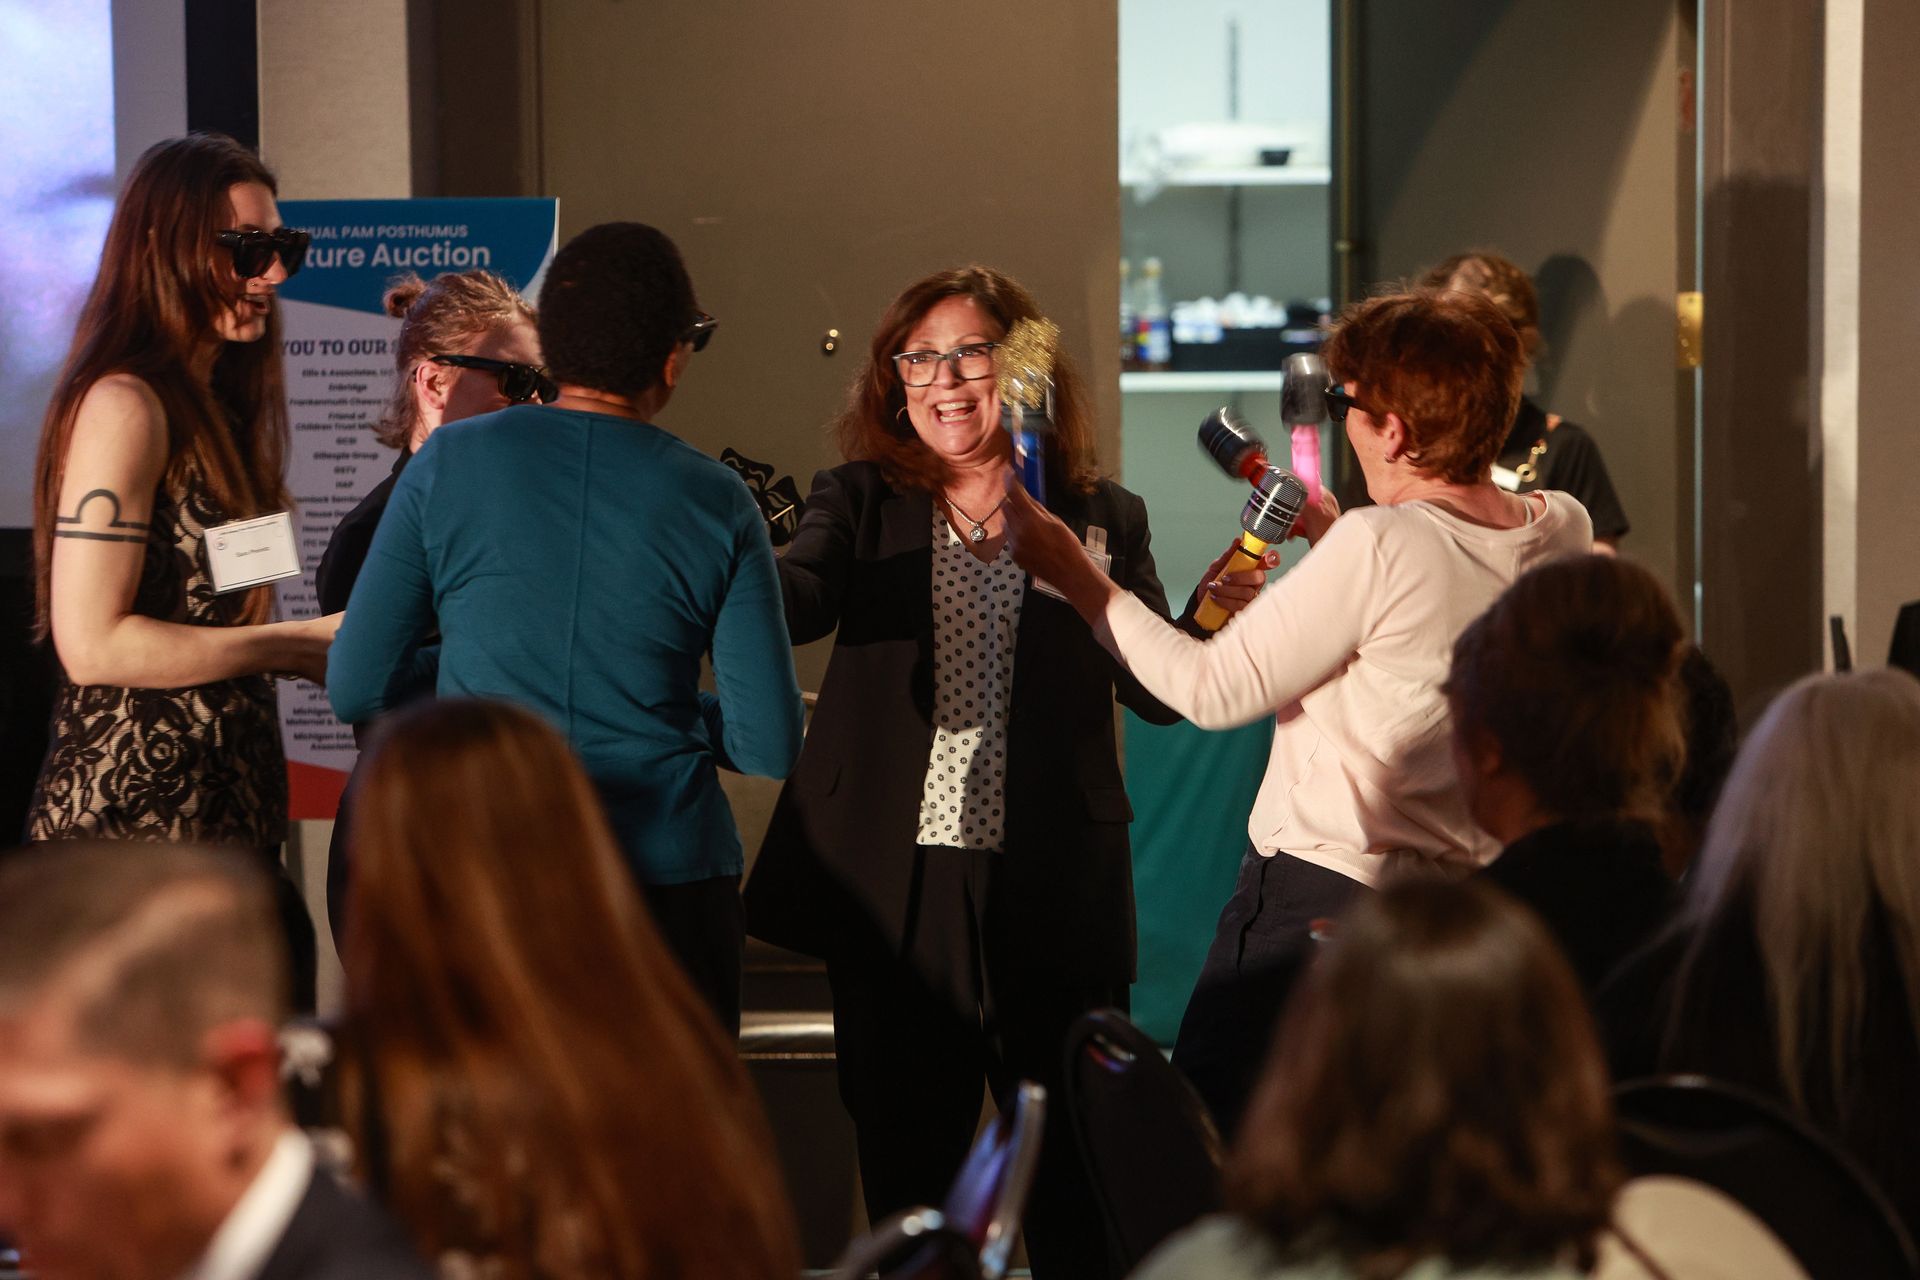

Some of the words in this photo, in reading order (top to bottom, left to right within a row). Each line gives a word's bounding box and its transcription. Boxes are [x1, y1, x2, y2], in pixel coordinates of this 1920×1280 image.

[306, 225, 337, 240] UAL
[341, 225, 374, 239] PAM
[377, 224, 469, 239] POSTHUMUS
[305, 244, 366, 268] ture
[370, 240, 491, 268] Auction
[319, 339, 344, 356] TO
[348, 339, 387, 355] OUR
